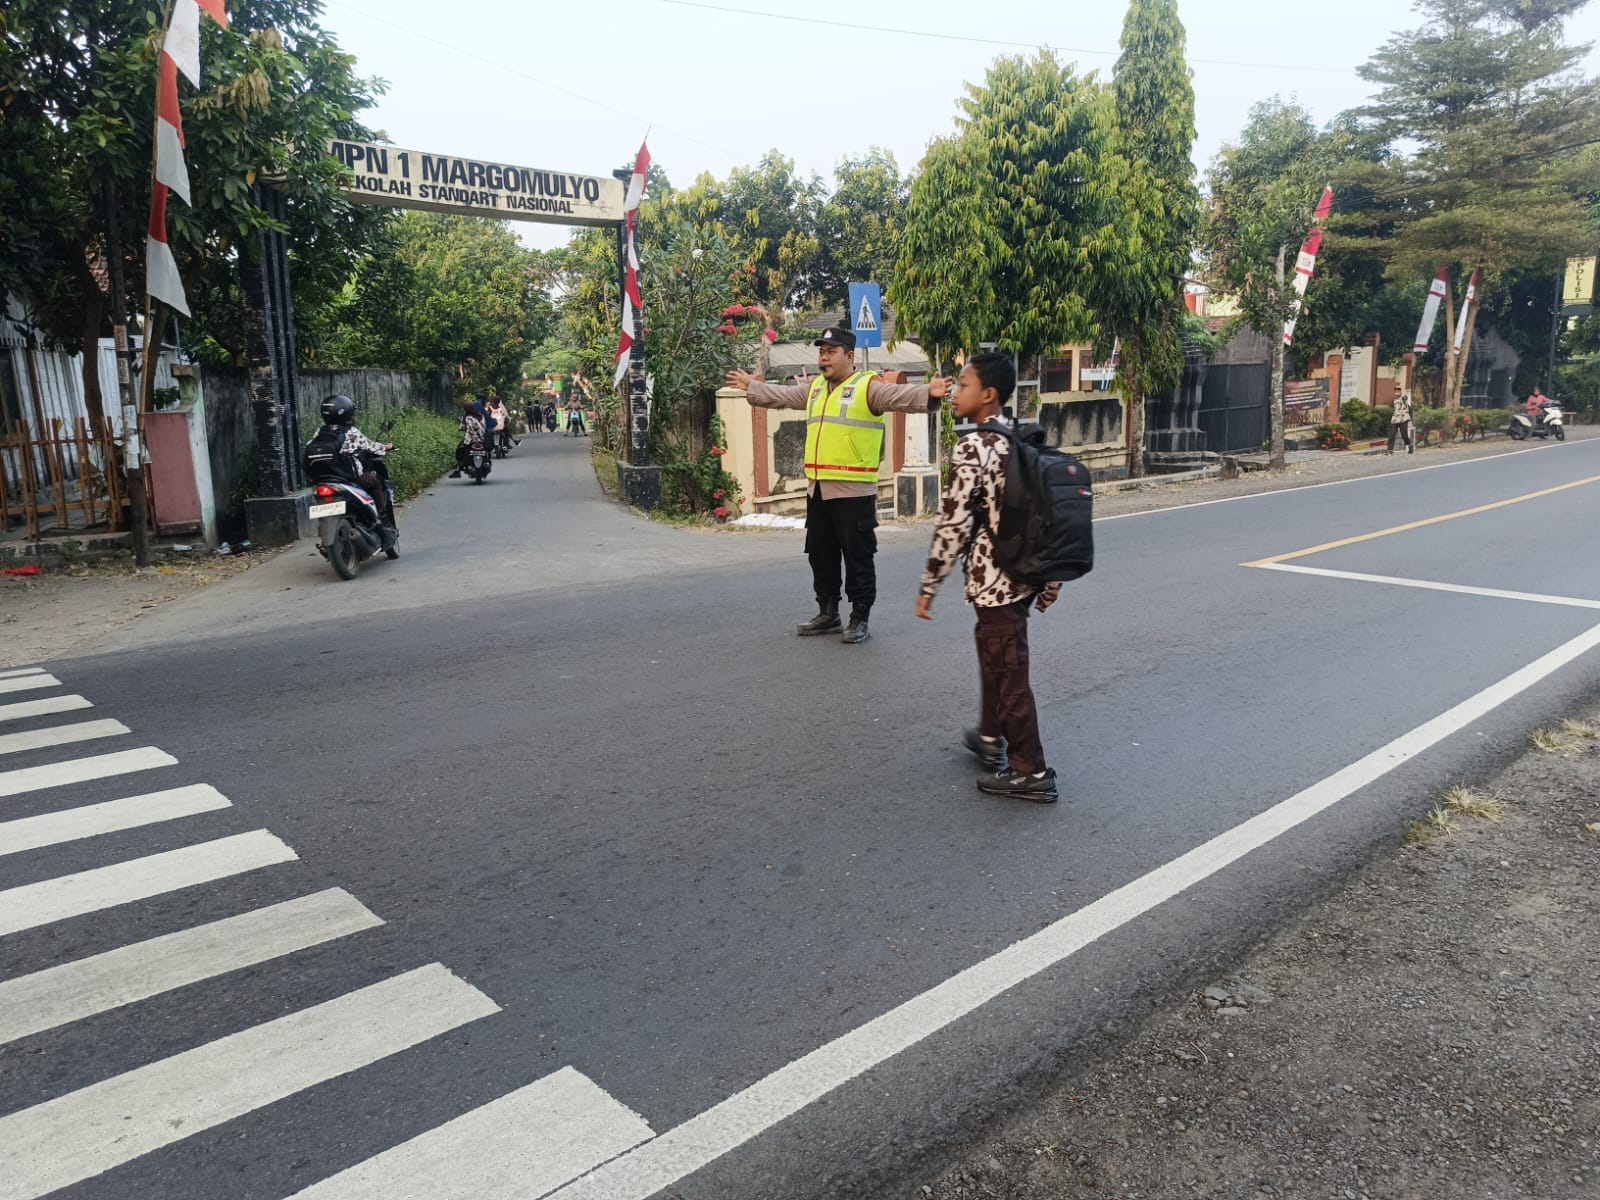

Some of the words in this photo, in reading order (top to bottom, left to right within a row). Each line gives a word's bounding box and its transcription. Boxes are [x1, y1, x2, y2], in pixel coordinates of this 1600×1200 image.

[353, 175, 412, 196] KOLAH
[419, 184, 499, 207] STANDART
[506, 195, 575, 214] NASIONAL
[397, 152, 410, 178] 1
[421, 155, 600, 201] MARGOMULYO
[1574, 262, 1585, 298] POLISI
